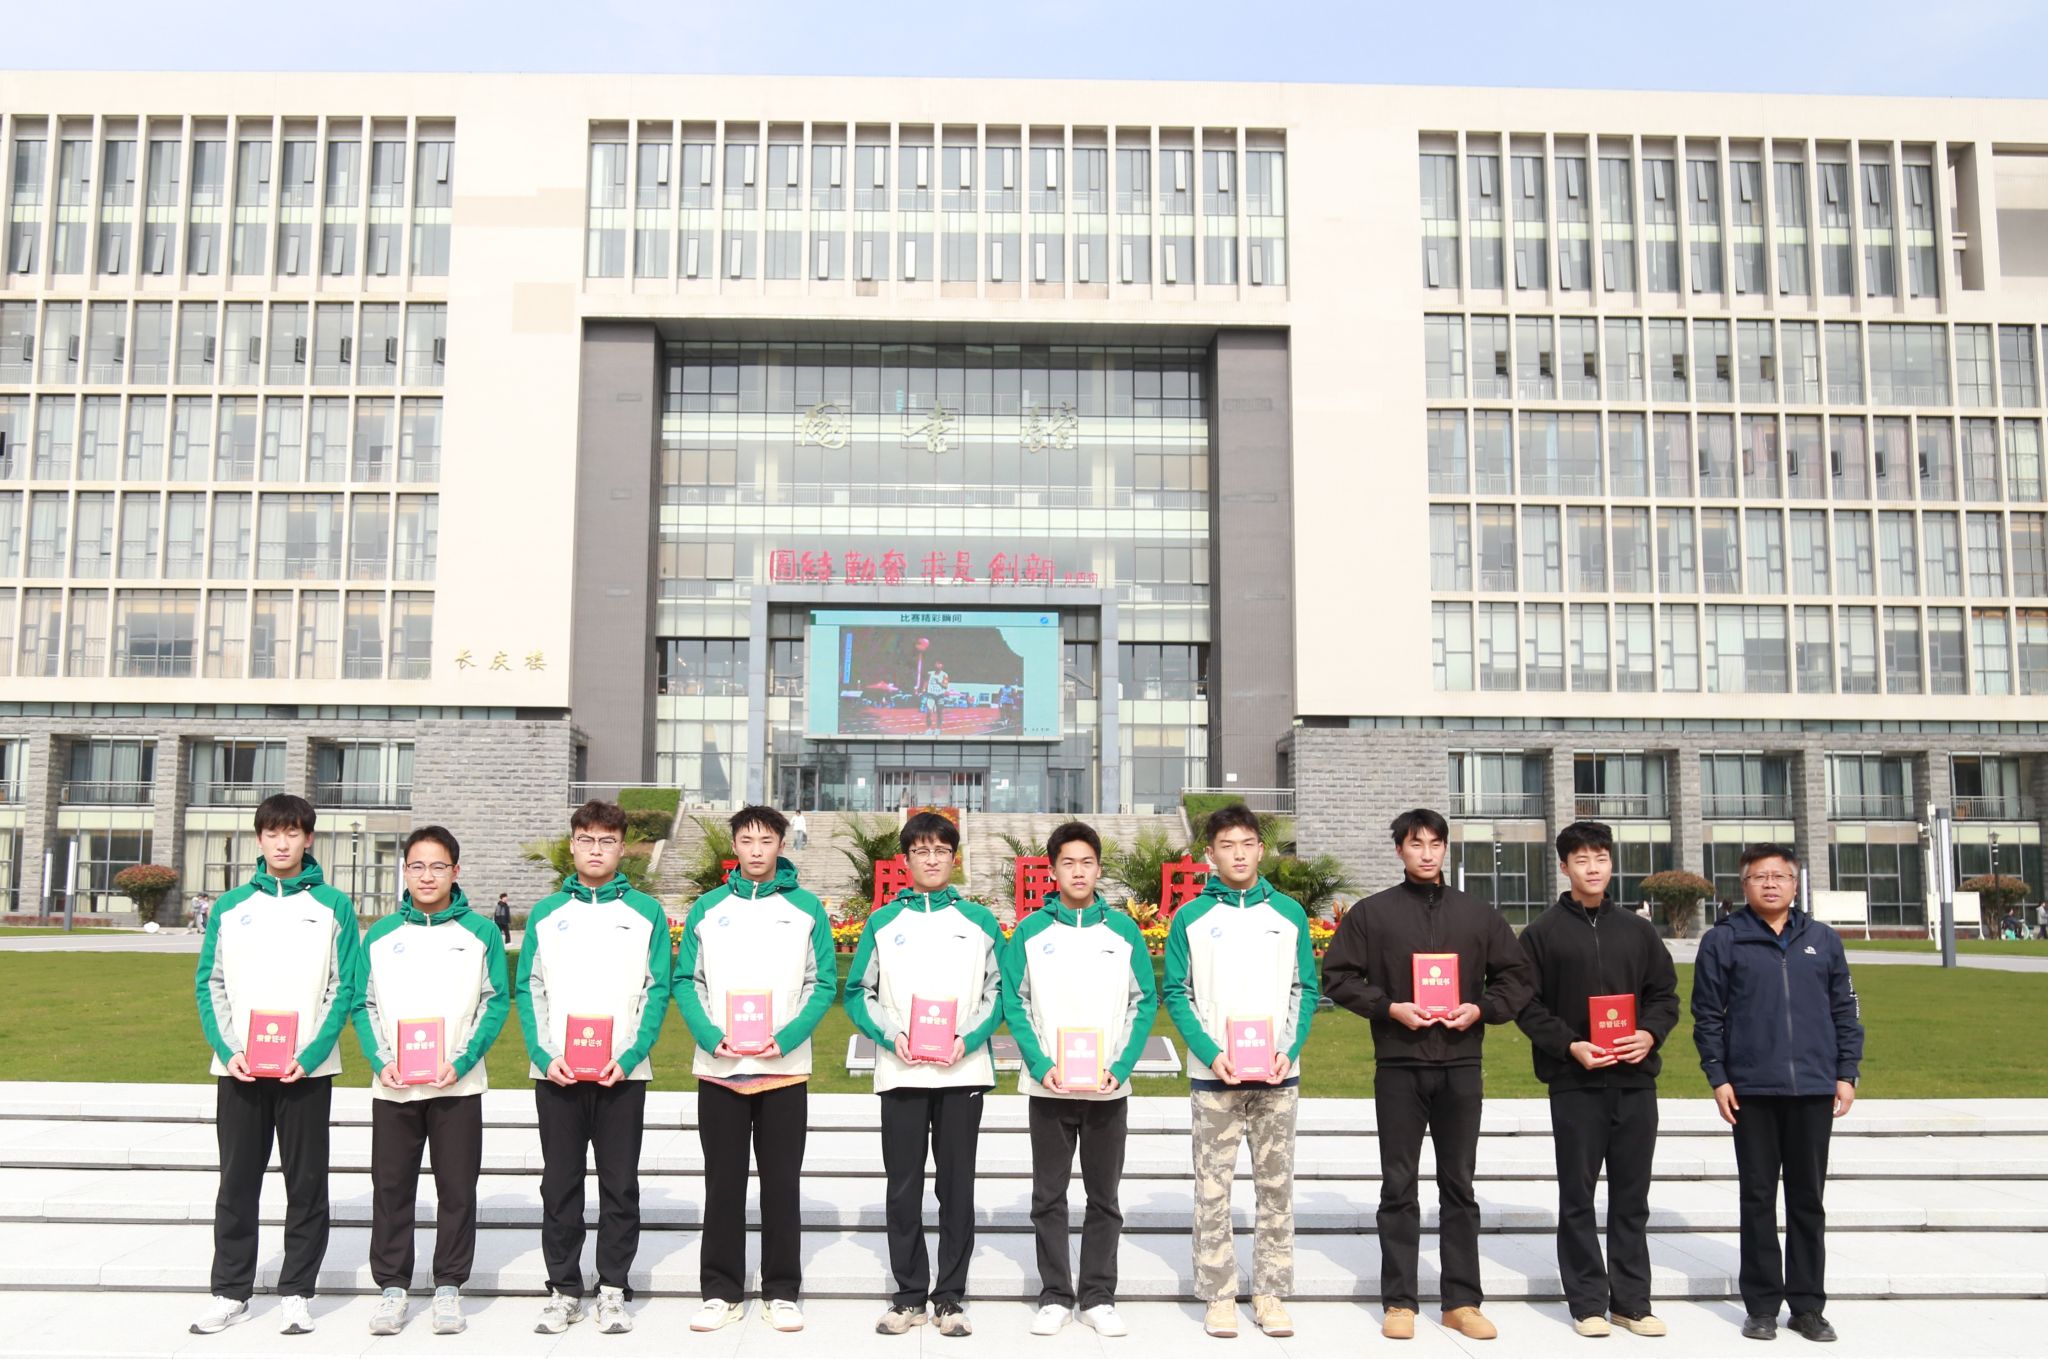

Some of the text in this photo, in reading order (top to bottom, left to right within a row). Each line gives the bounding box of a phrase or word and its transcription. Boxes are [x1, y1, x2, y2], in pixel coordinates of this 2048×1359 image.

[900, 613, 962, 623] 比赛精彩瞬间
[454, 649, 548, 671] 长庆楼
